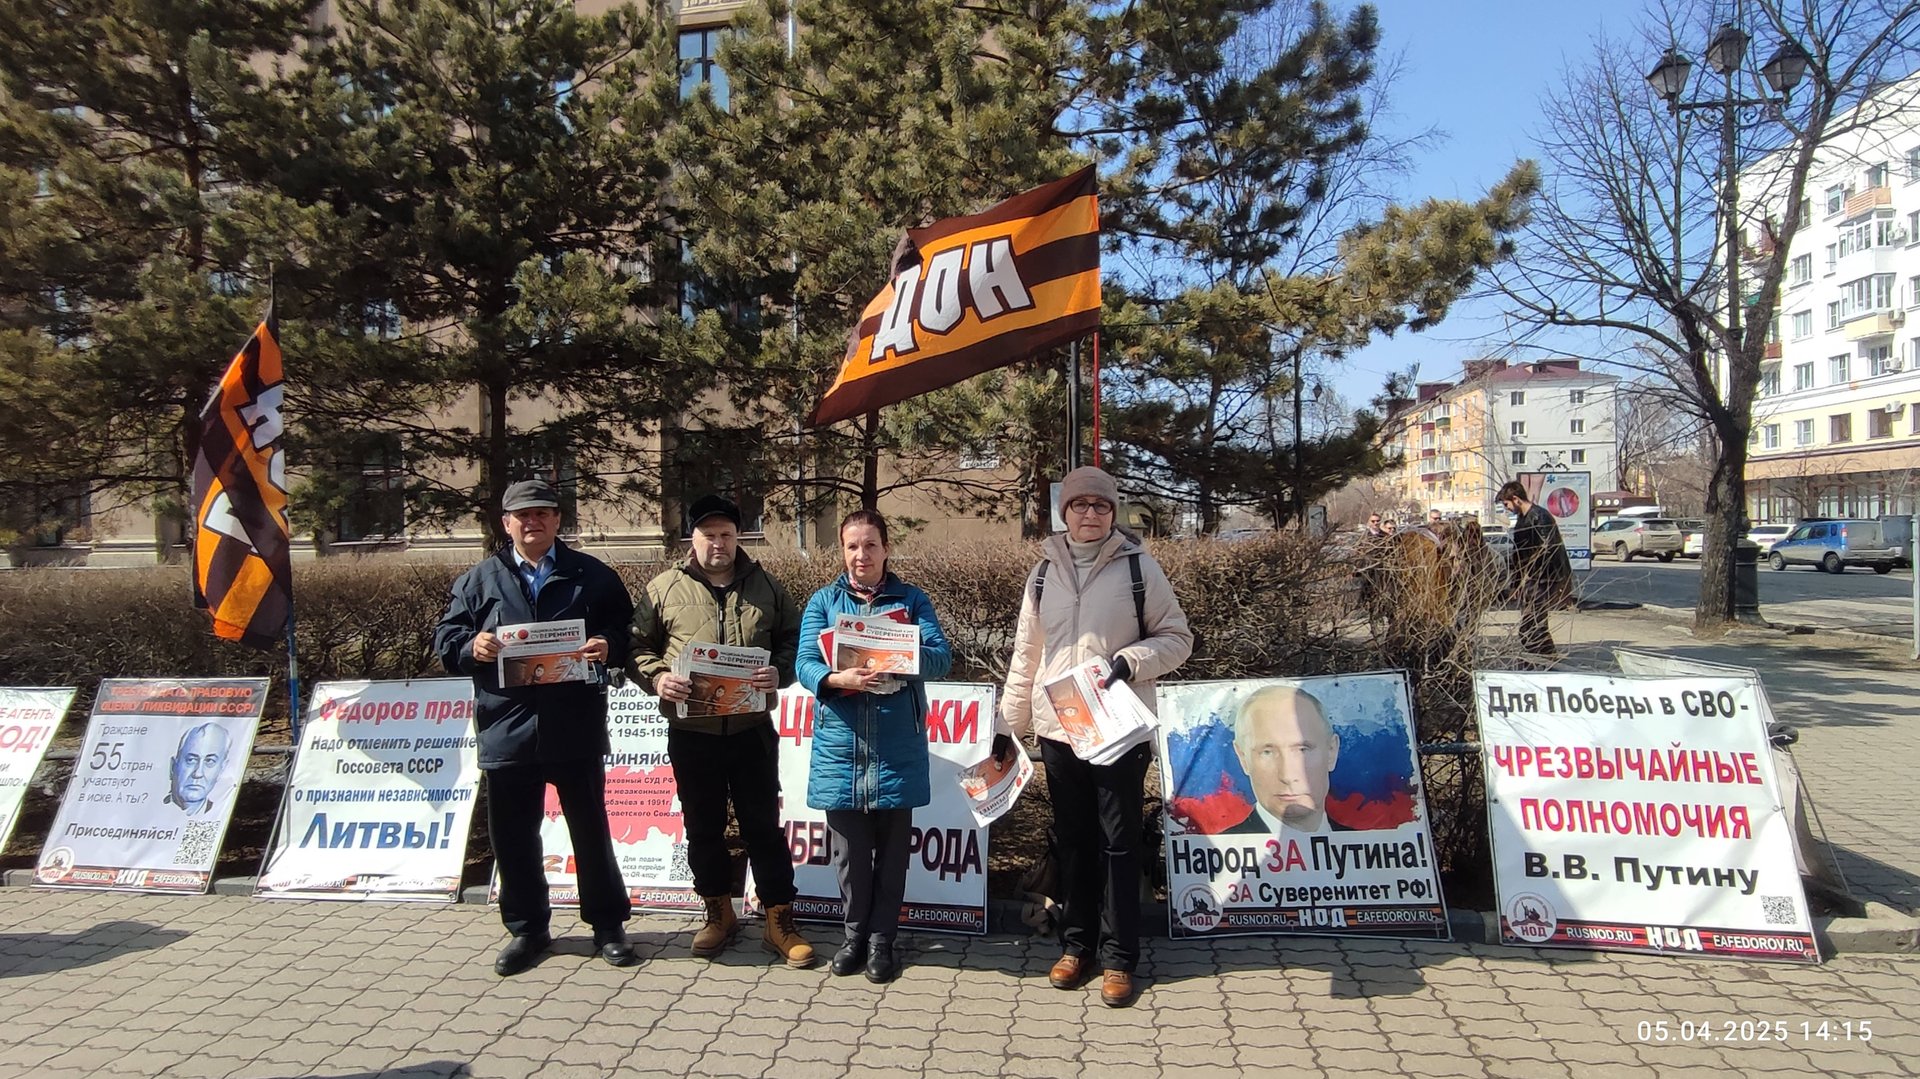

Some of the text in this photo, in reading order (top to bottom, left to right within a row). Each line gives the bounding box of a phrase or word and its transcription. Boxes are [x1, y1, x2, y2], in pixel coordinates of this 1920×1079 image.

[531, 631, 580, 640] СУВЕРЕНИТЕТ
[719, 655, 765, 666] СУВЕРЕНИТЕТ
[190, 687, 253, 698] ПРАВОВУЮ
[140, 701, 217, 714] ЛИКВИДАЦИИ
[1487, 685, 1539, 718] Для
[1546, 687, 1654, 720] Победы
[1662, 695, 1676, 716] в
[614, 714, 669, 724] ОТЕЧЕС
[924, 699, 980, 744] ЖИ
[99, 723, 148, 737] Граждане
[617, 728, 669, 738] 1945-199
[0, 725, 51, 753] ОД!
[311, 735, 477, 752] Надо отменить решение
[90, 742, 125, 771] 55
[1494, 741, 1764, 786] ЧРЕЗВЫЧАЙНЫЕ
[336, 758, 444, 775] Госсовета СССР
[82, 775, 136, 789] участвуют
[607, 777, 675, 786] рховный СУД РФ
[78, 792, 85, 803] в
[116, 791, 123, 803] А
[126, 792, 149, 804] ты?
[295, 787, 472, 805] о признании независимости
[607, 809, 651, 818] Советского
[1520, 797, 1753, 840] ПОЛНОМОЧИЯ
[65, 822, 179, 842] Присоединяйся!
[909, 826, 983, 883] РОДА
[1171, 832, 1428, 883] Народ ЗА Путина!
[114, 869, 150, 886] НОД
[1524, 851, 1760, 896] В.В. Путину
[548, 889, 580, 900] SNOD.R
[640, 892, 701, 904] EAFEDOROV.RU
[1228, 883, 1254, 903] ЗА
[1259, 881, 1391, 909] Суверенитет
[1396, 878, 1434, 900] РФ!
[792, 901, 845, 916] RUSNOD.RU
[908, 908, 976, 924] EAFEDOROV.RU
[1190, 916, 1214, 927] НОД
[1228, 914, 1287, 926] RUSNOD.RU
[1299, 908, 1348, 928] НОД
[1356, 910, 1433, 924] EAFEDOROV.RU
[1520, 926, 1548, 938] НОД
[1566, 926, 1634, 943] RUSNOD.RU
[1645, 925, 1705, 951] НОД
[1712, 934, 1804, 953] EAFEDOROV.RU
